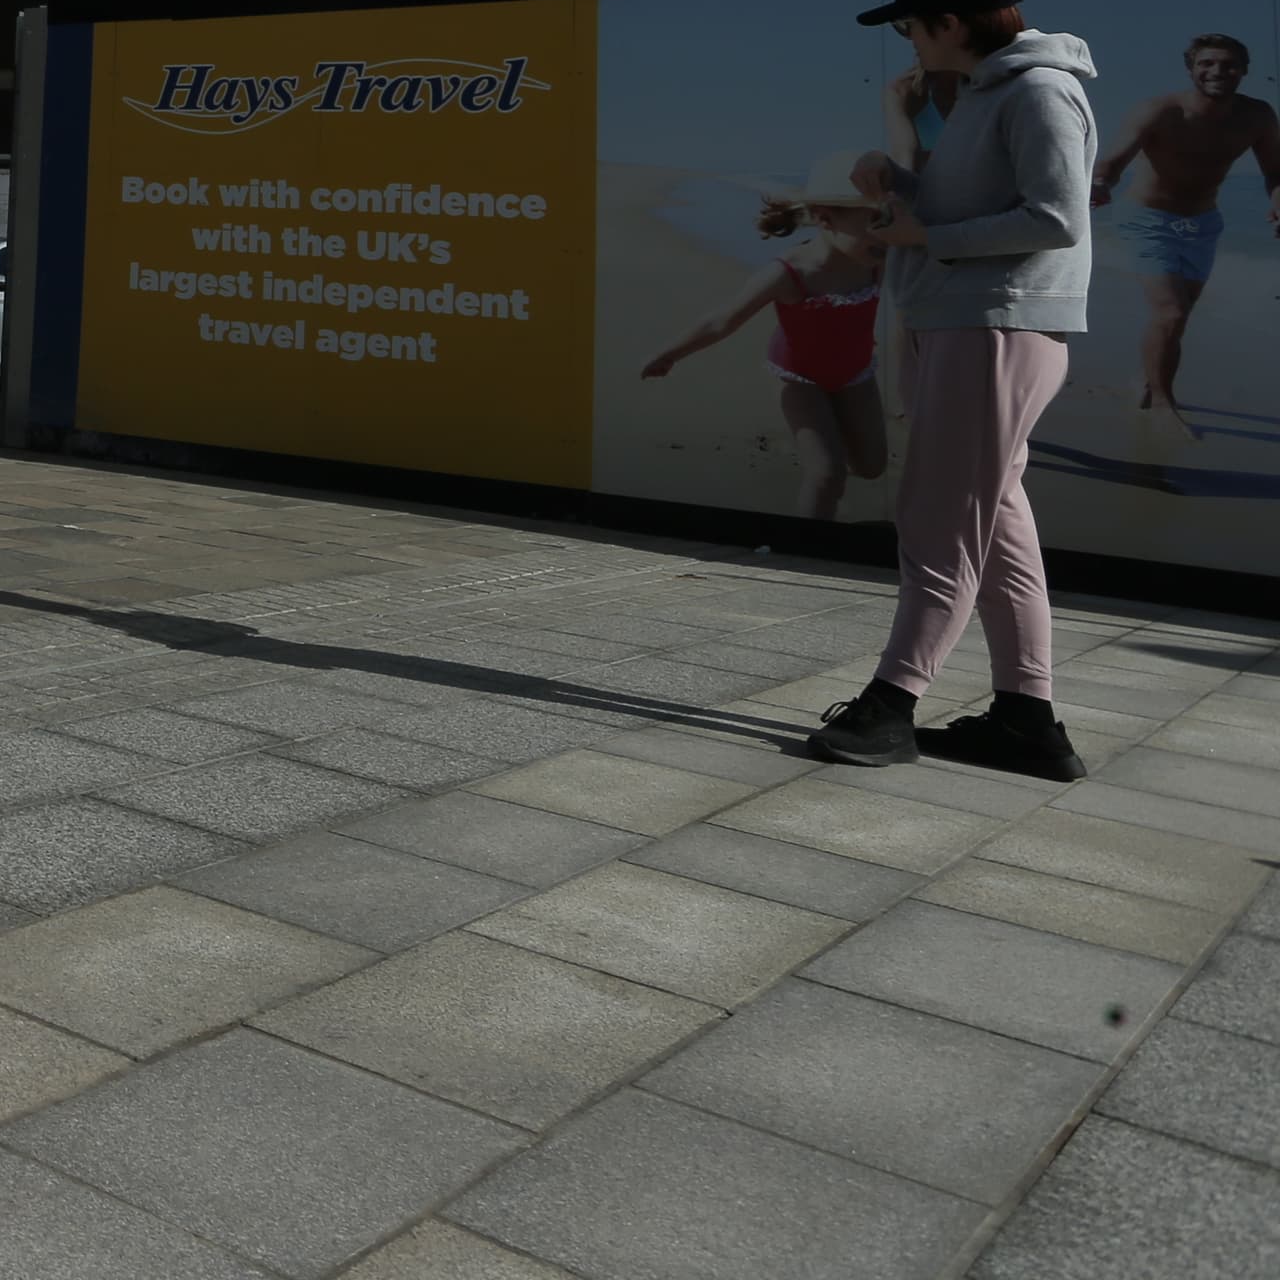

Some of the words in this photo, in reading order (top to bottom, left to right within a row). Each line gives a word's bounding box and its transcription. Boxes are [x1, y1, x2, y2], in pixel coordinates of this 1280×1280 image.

[153, 63, 299, 124] Hays
[312, 57, 528, 114] Travel
[121, 176, 209, 207] Book
[219, 178, 300, 210] with
[309, 183, 547, 220] confidence
[191, 223, 272, 255] with
[281, 226, 345, 258] the
[356, 230, 452, 266] UK's
[129, 262, 253, 301] largest
[262, 271, 530, 321] independent
[198, 313, 305, 350] travel
[315, 327, 439, 363] agent
